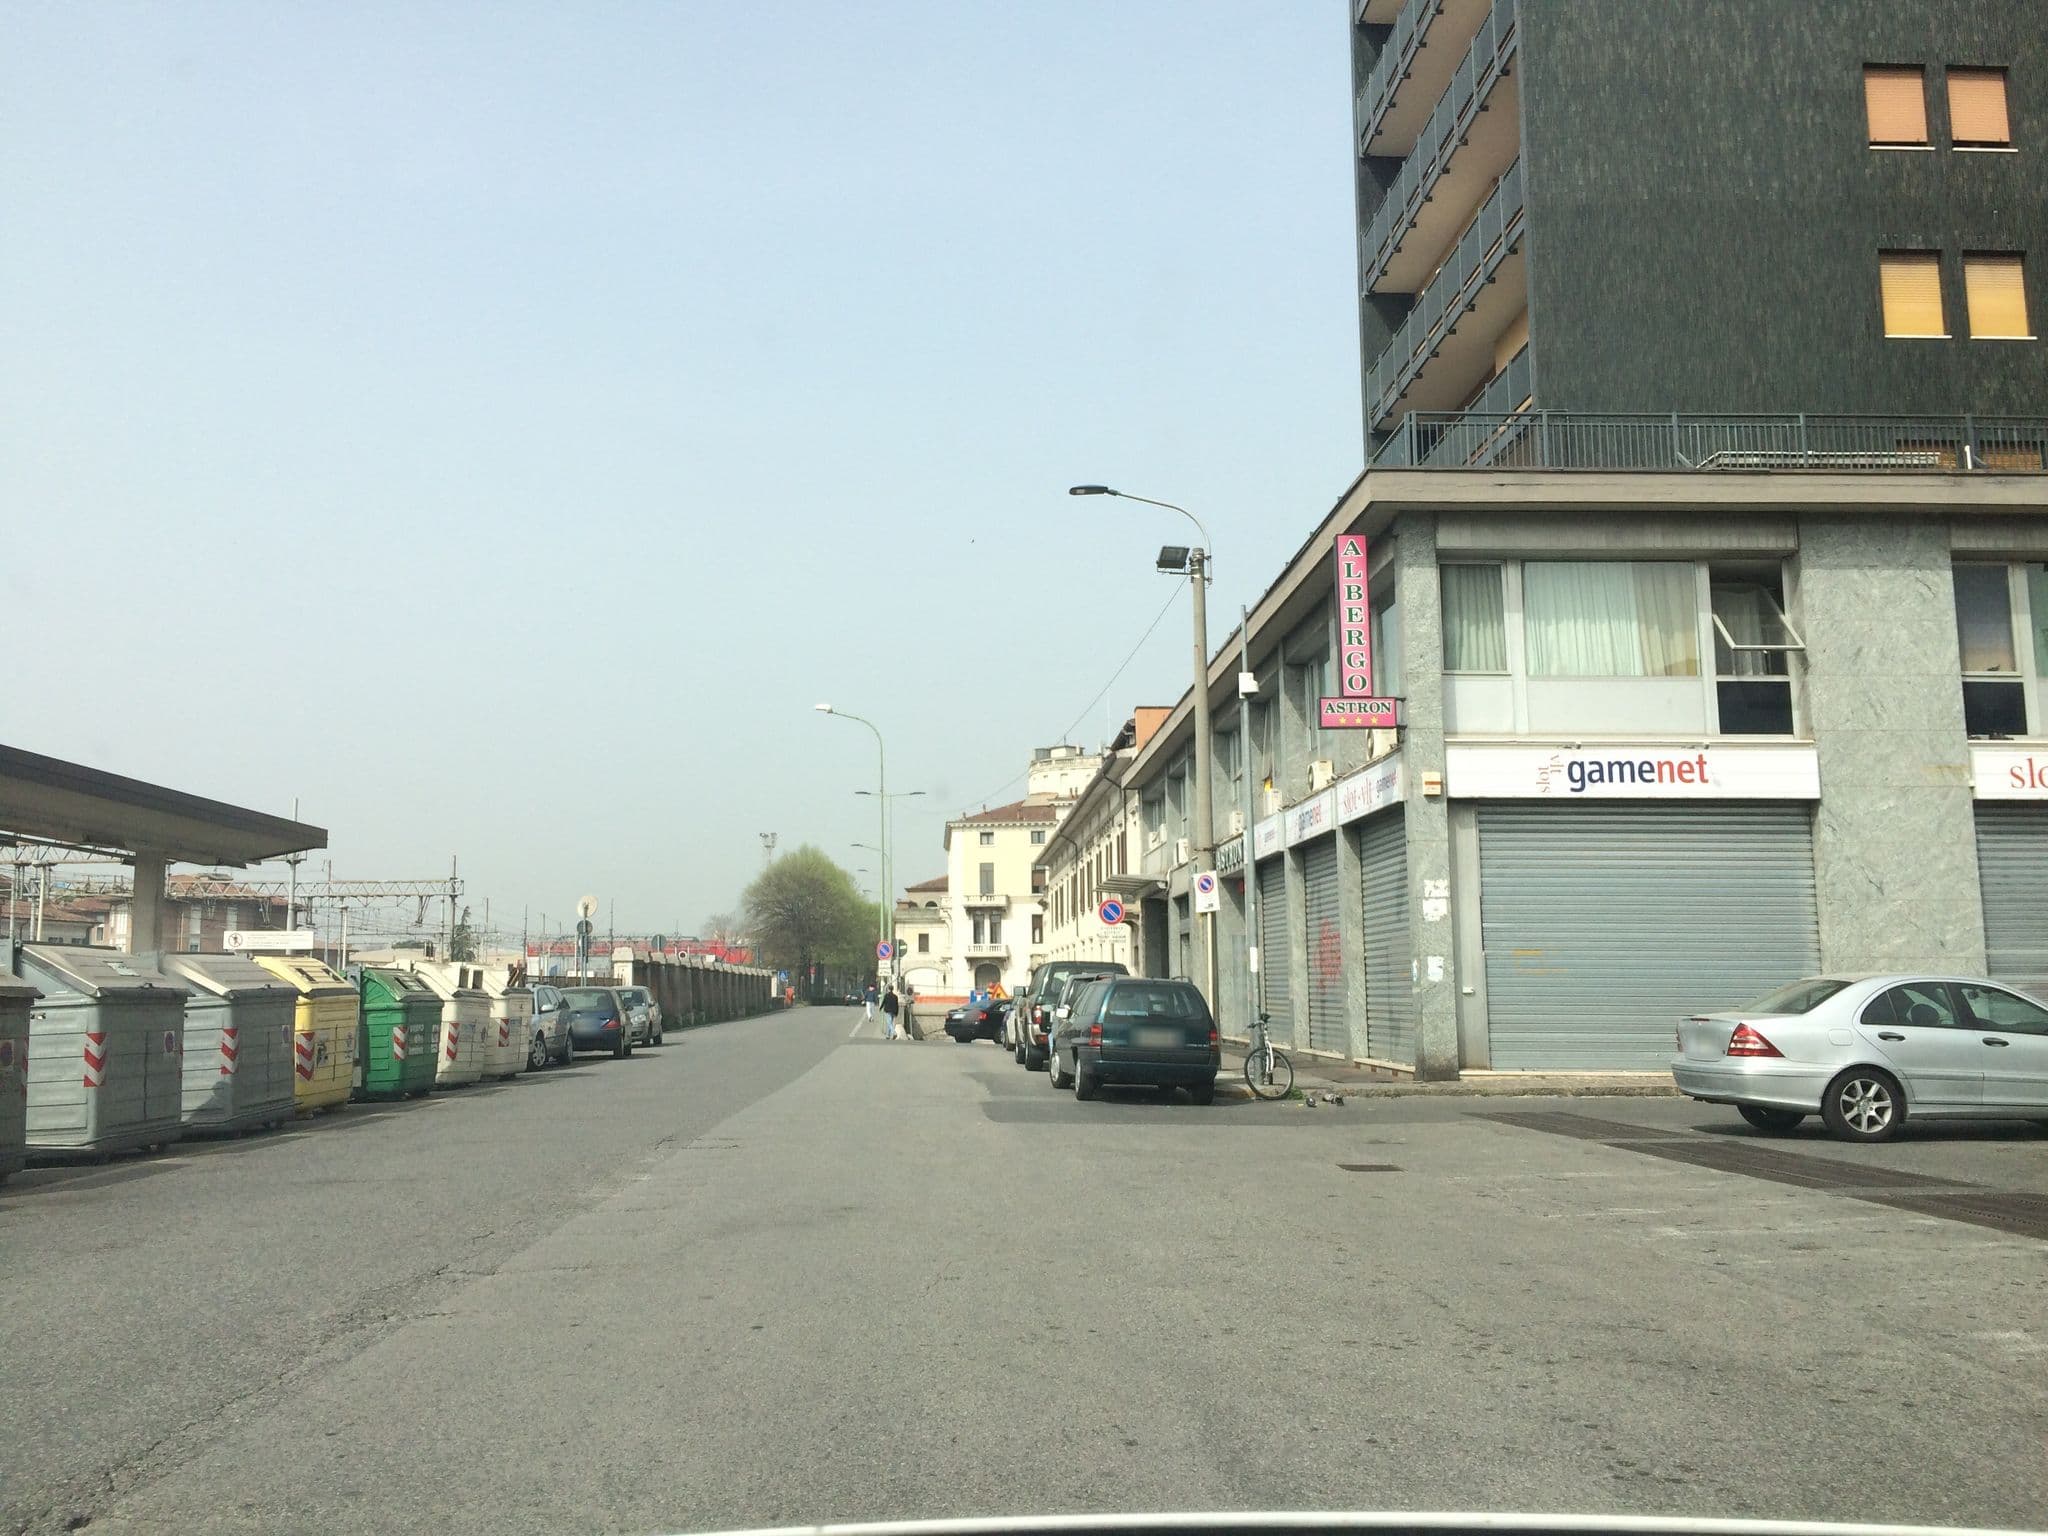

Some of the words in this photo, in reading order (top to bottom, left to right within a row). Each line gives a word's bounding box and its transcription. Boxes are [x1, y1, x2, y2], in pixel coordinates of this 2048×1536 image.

[1341, 538, 1368, 693] ALBERGO
[1324, 701, 1392, 715] ASTRON
[1535, 766, 1550, 794] slot
[1567, 753, 1710, 793] gamenet
